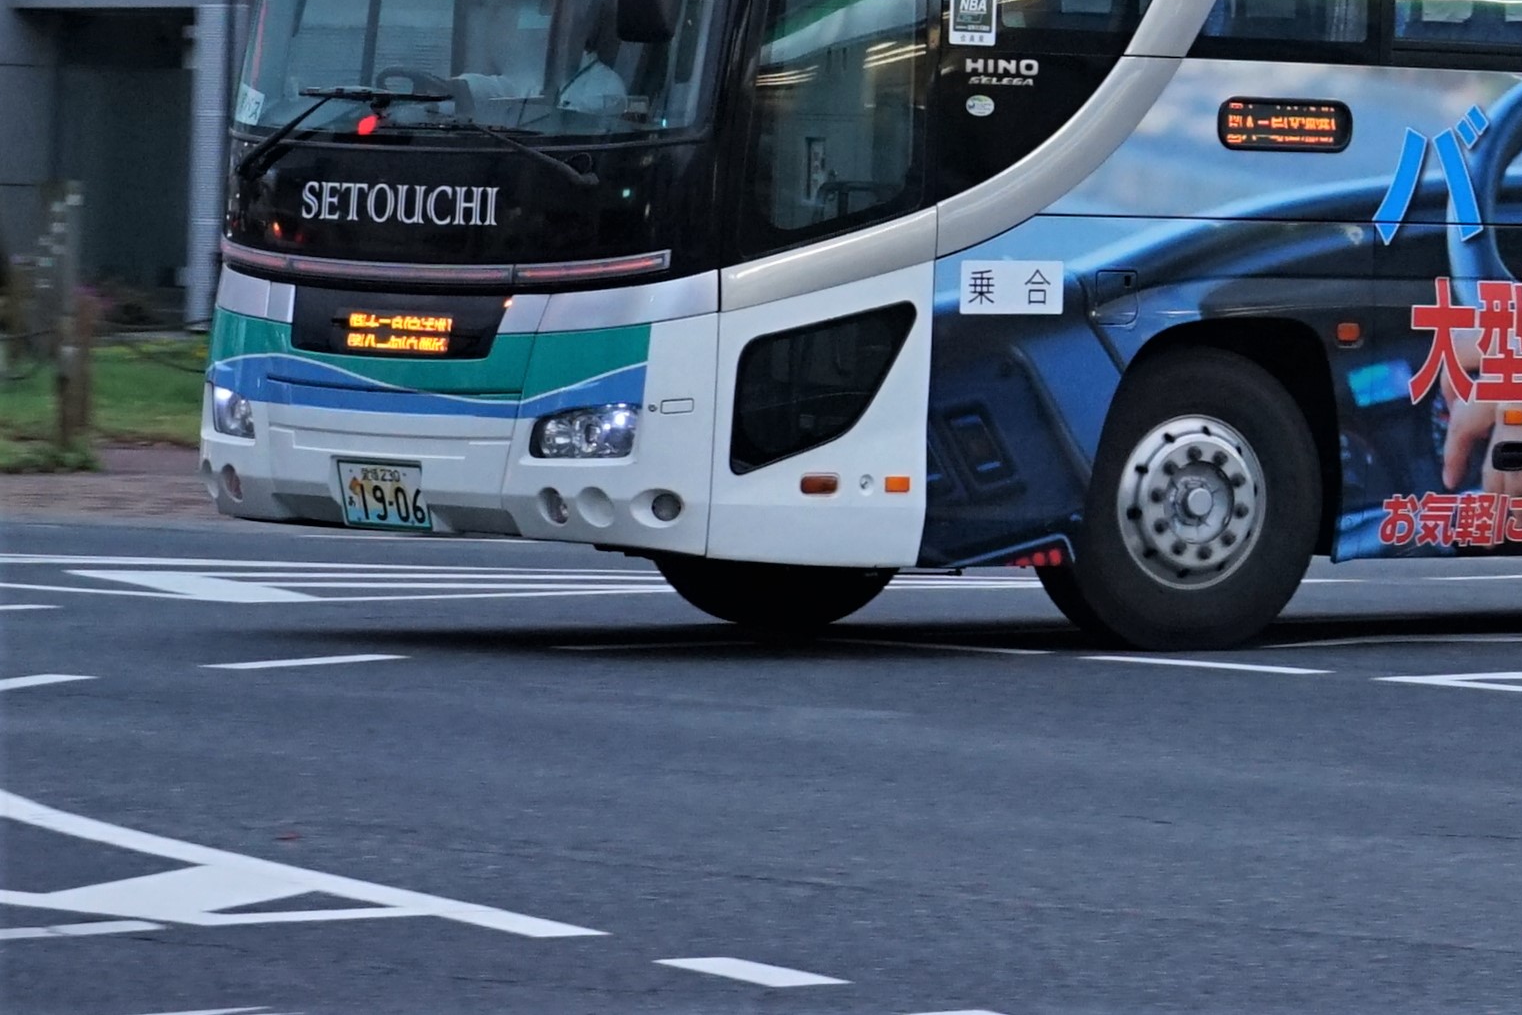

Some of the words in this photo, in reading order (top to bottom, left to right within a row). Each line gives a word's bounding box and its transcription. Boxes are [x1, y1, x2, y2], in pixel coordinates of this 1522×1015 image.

[965, 58, 1039, 76] HINO
[301, 180, 499, 226] SETOUCHI
[968, 269, 1051, 305] 乗合
[360, 482, 426, 524] 19-06
